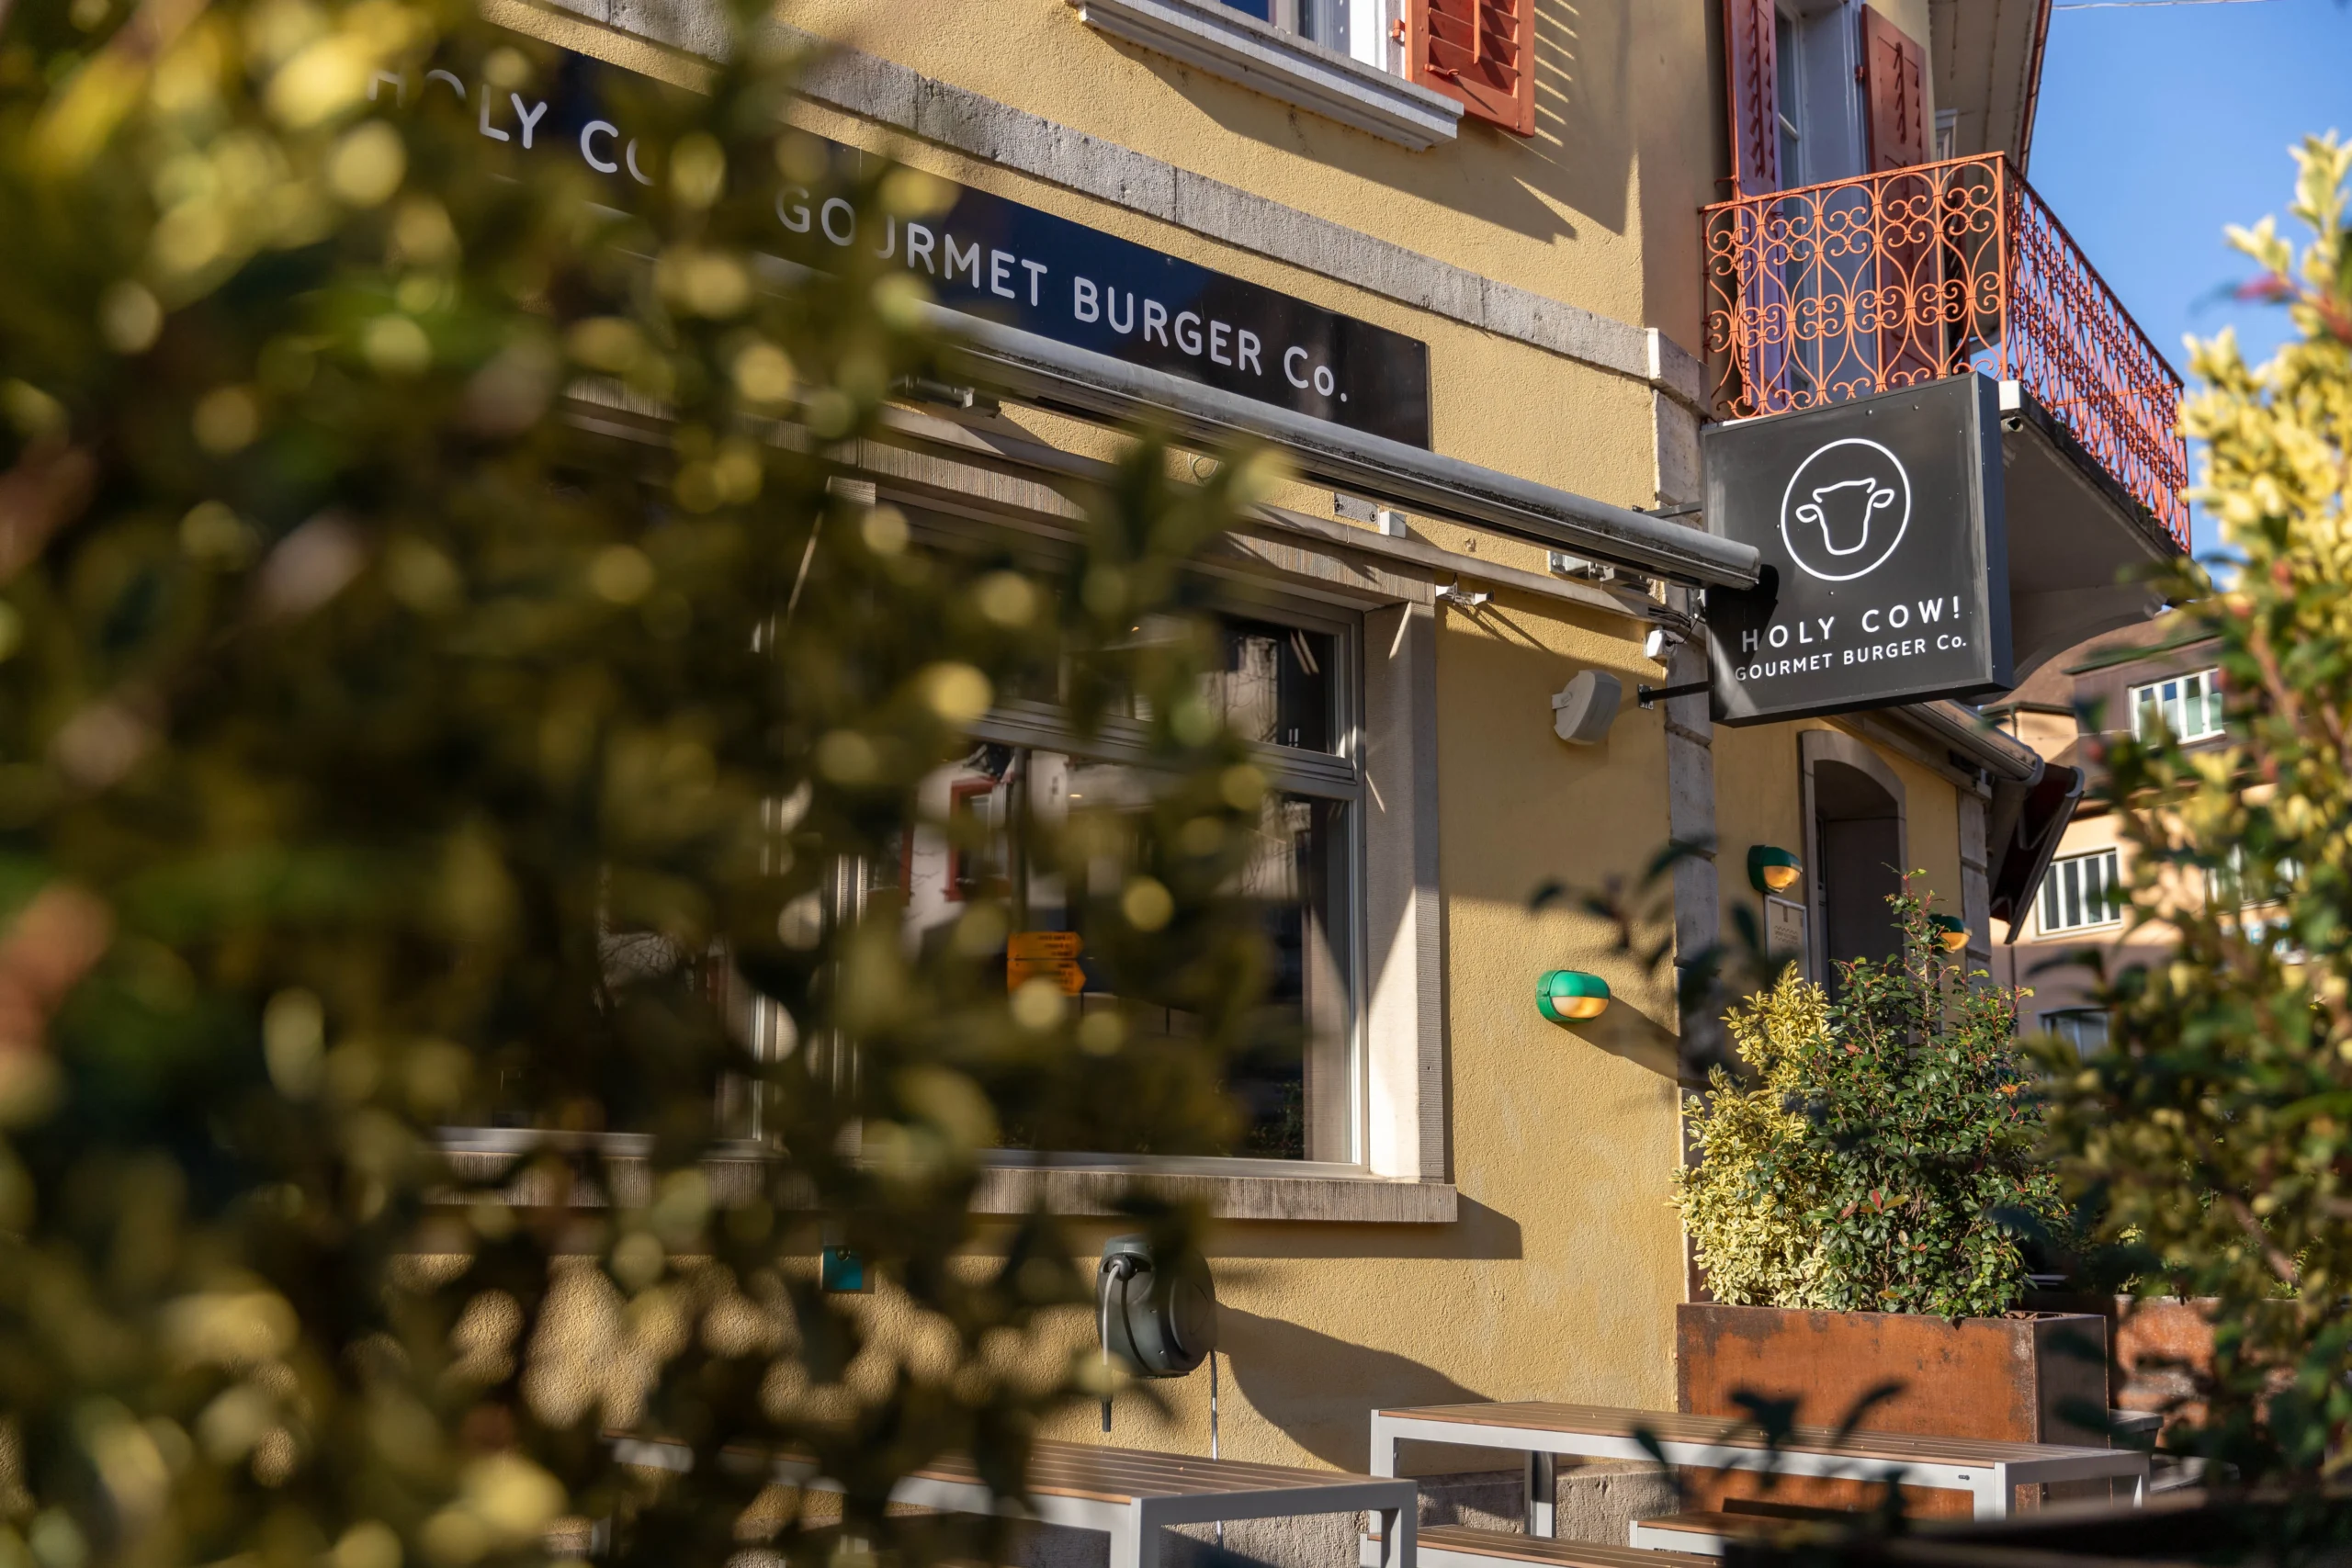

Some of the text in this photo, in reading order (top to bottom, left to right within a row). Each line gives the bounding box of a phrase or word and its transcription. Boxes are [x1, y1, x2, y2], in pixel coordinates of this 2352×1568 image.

[1073, 276, 1262, 377] BURGER
[1283, 346, 1349, 403] Co.
[1741, 595, 1961, 653] HOLY COW!
[1735, 634, 1968, 682] GOURMET BURGER Co.
